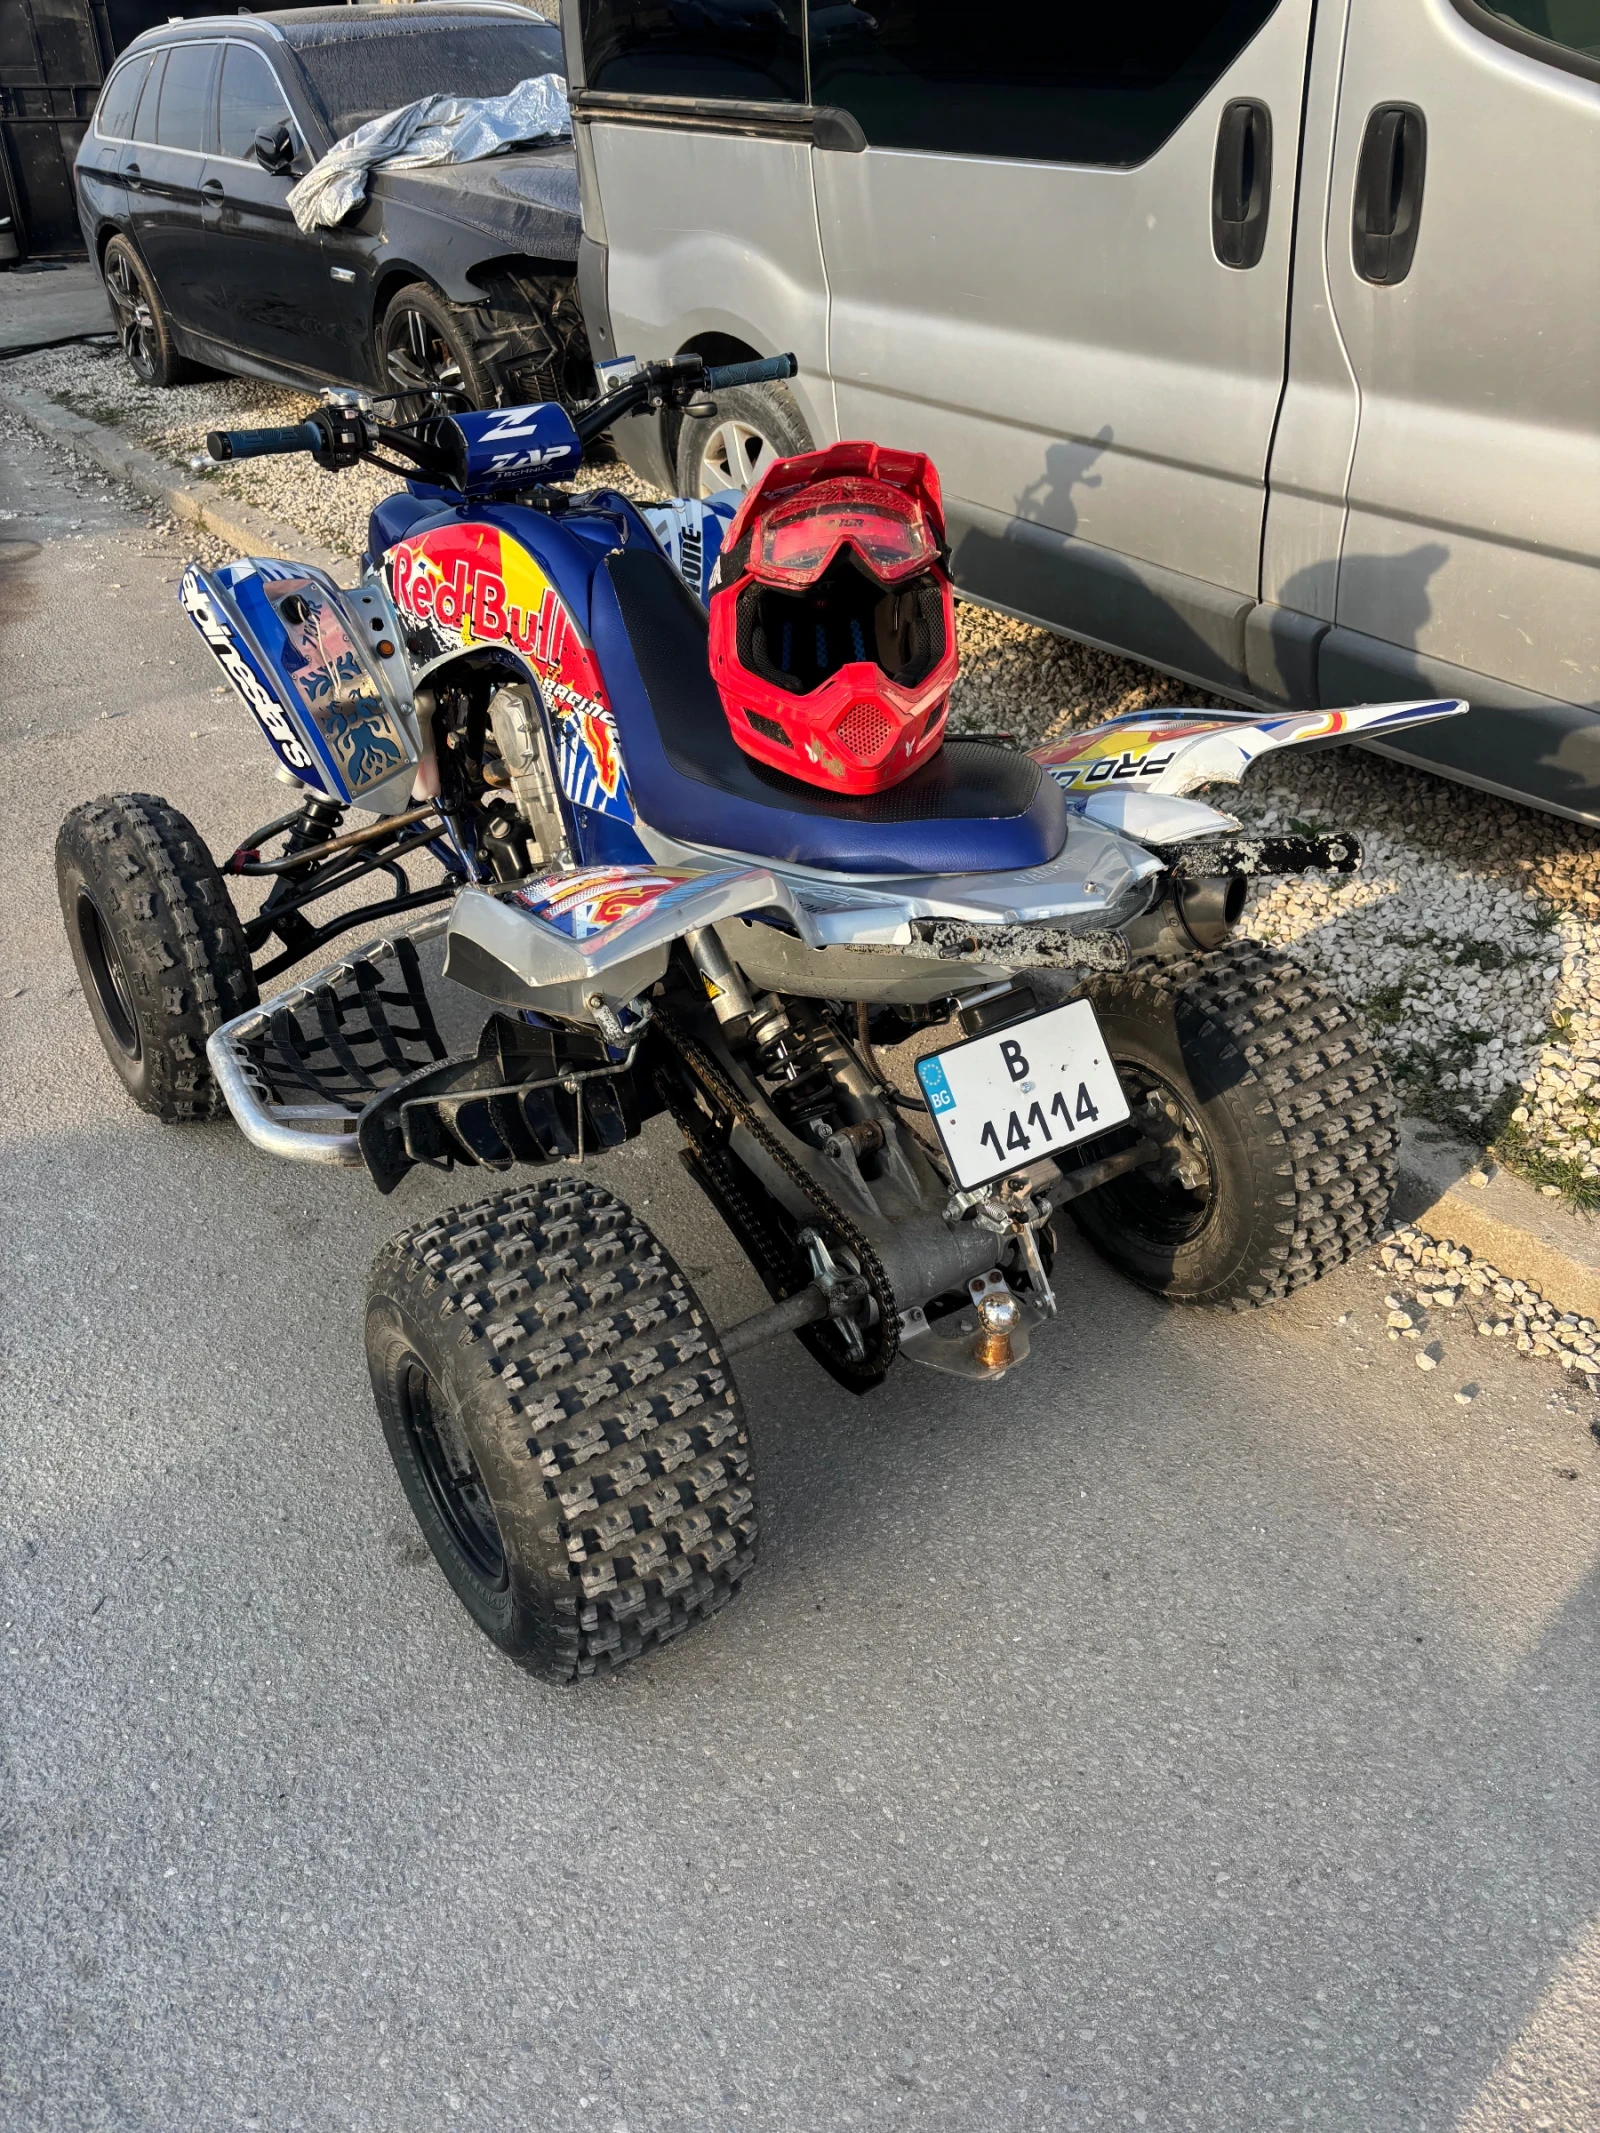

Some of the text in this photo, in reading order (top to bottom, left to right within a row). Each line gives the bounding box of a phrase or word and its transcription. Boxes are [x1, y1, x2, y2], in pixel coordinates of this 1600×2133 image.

[481, 445, 572, 475] ZAP
[495, 463, 553, 479] TECHNIX
[392, 542, 569, 667] Red Bull
[182, 571, 312, 769] alpinestars
[1085, 752, 1176, 783] PRO
[999, 1039, 1030, 1083] B
[930, 1090, 951, 1109] BG
[979, 1081, 1099, 1162] 14114
